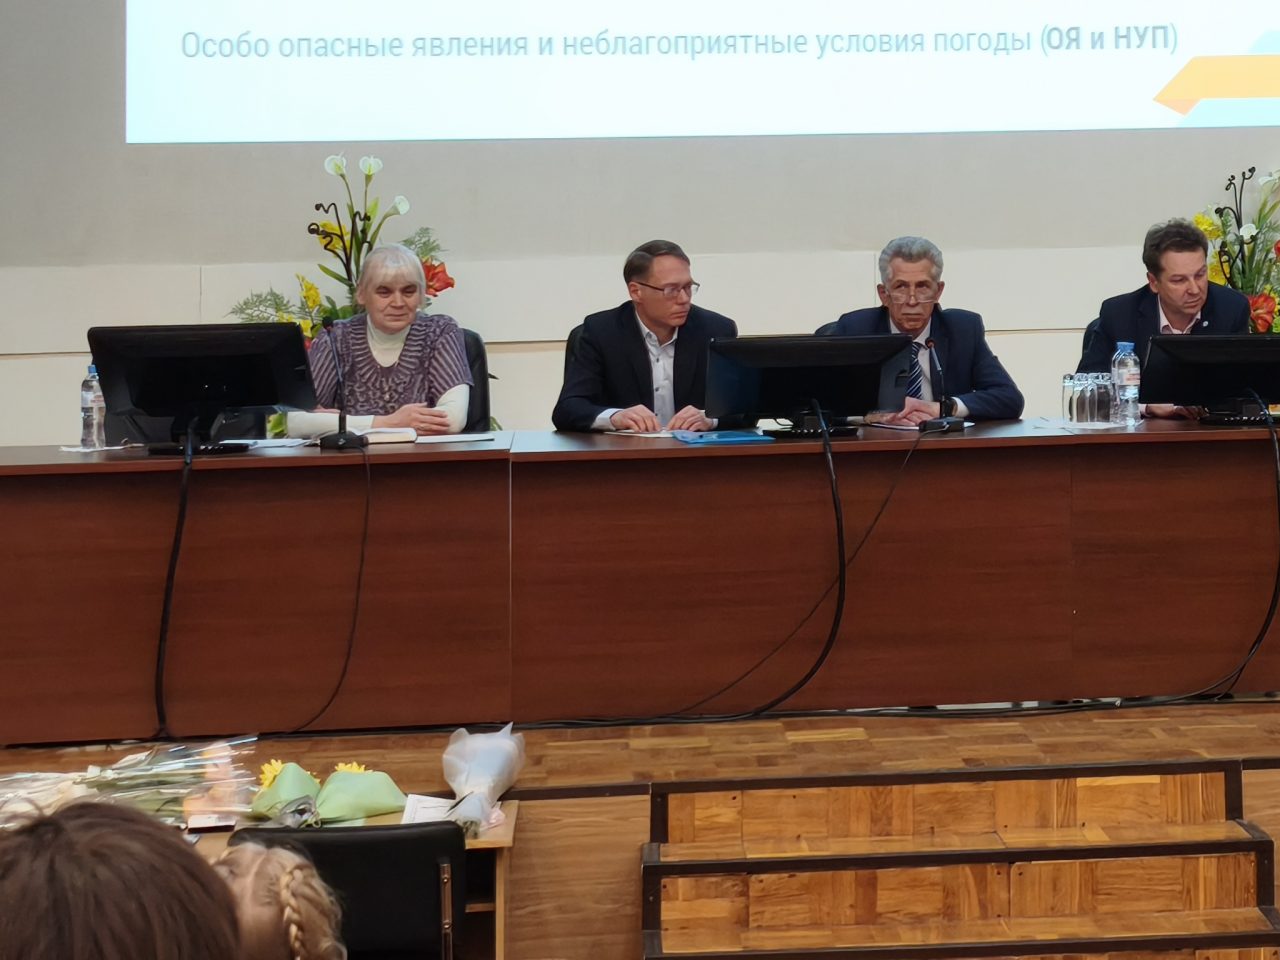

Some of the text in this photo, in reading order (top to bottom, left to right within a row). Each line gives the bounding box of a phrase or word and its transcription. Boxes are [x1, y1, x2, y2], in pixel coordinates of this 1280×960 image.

[181, 22, 1178, 61] Особо опасные явления и неблагоприятные условия погоды (ОЯ и НУП)
